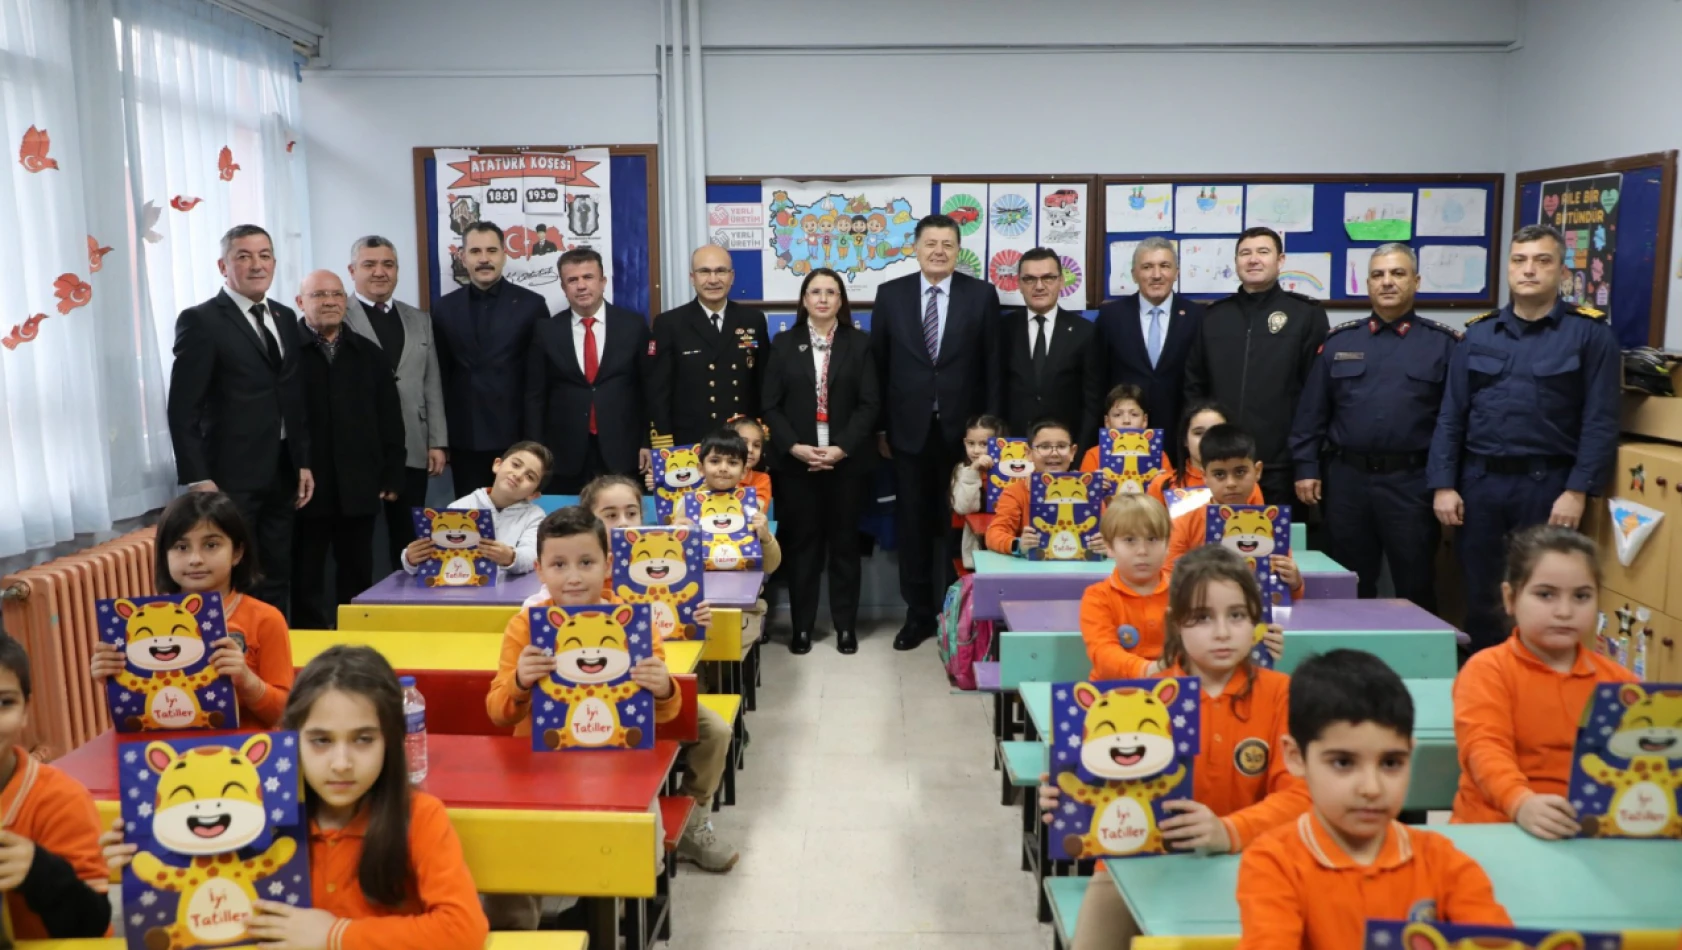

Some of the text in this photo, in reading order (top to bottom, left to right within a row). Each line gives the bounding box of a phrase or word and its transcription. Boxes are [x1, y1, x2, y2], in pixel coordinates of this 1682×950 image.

[488, 190, 516, 201] 1881
[453, 556, 463, 571] İyi
[445, 571, 470, 579] Tatiller
[165, 692, 178, 707] İyi
[153, 709, 193, 719] Tatiller
[586, 703, 599, 721] İyi
[573, 722, 612, 734] Tatiller
[1116, 805, 1130, 825] İyi
[1619, 809, 1666, 822] Tatiller
[1100, 827, 1147, 840] Tatiller
[209, 886, 228, 909] İyi
[190, 908, 250, 928] Tatiller
